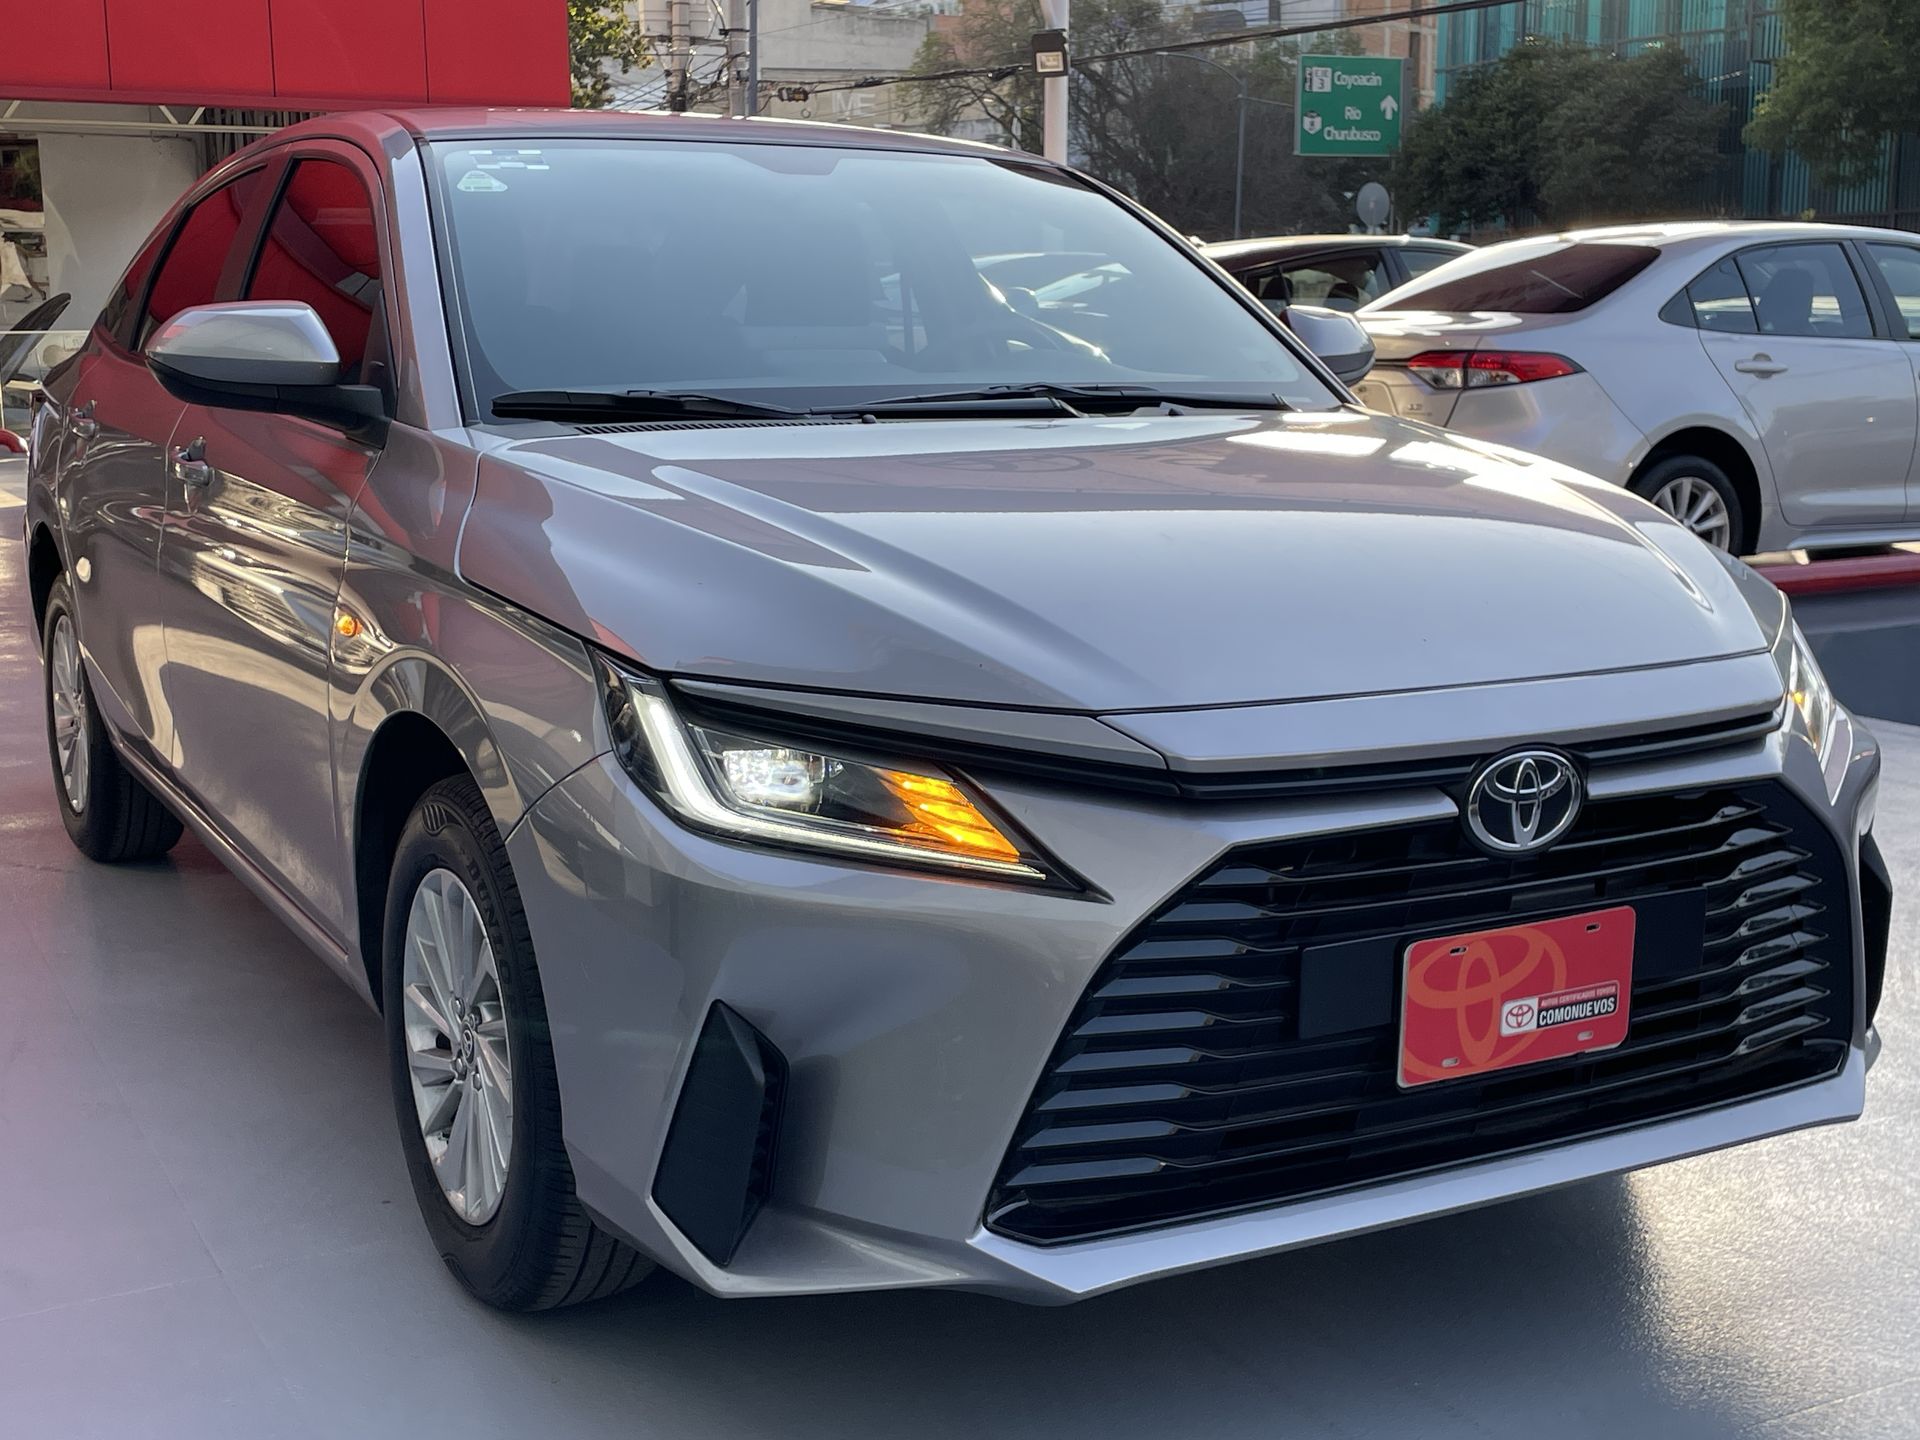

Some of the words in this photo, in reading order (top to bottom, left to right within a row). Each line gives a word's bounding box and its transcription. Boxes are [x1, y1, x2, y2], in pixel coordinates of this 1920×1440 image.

[1334, 71, 1382, 90] Coyoacán
[1323, 126, 1382, 141] Churubusco
[1539, 997, 1616, 1026] COMONUEVOS
